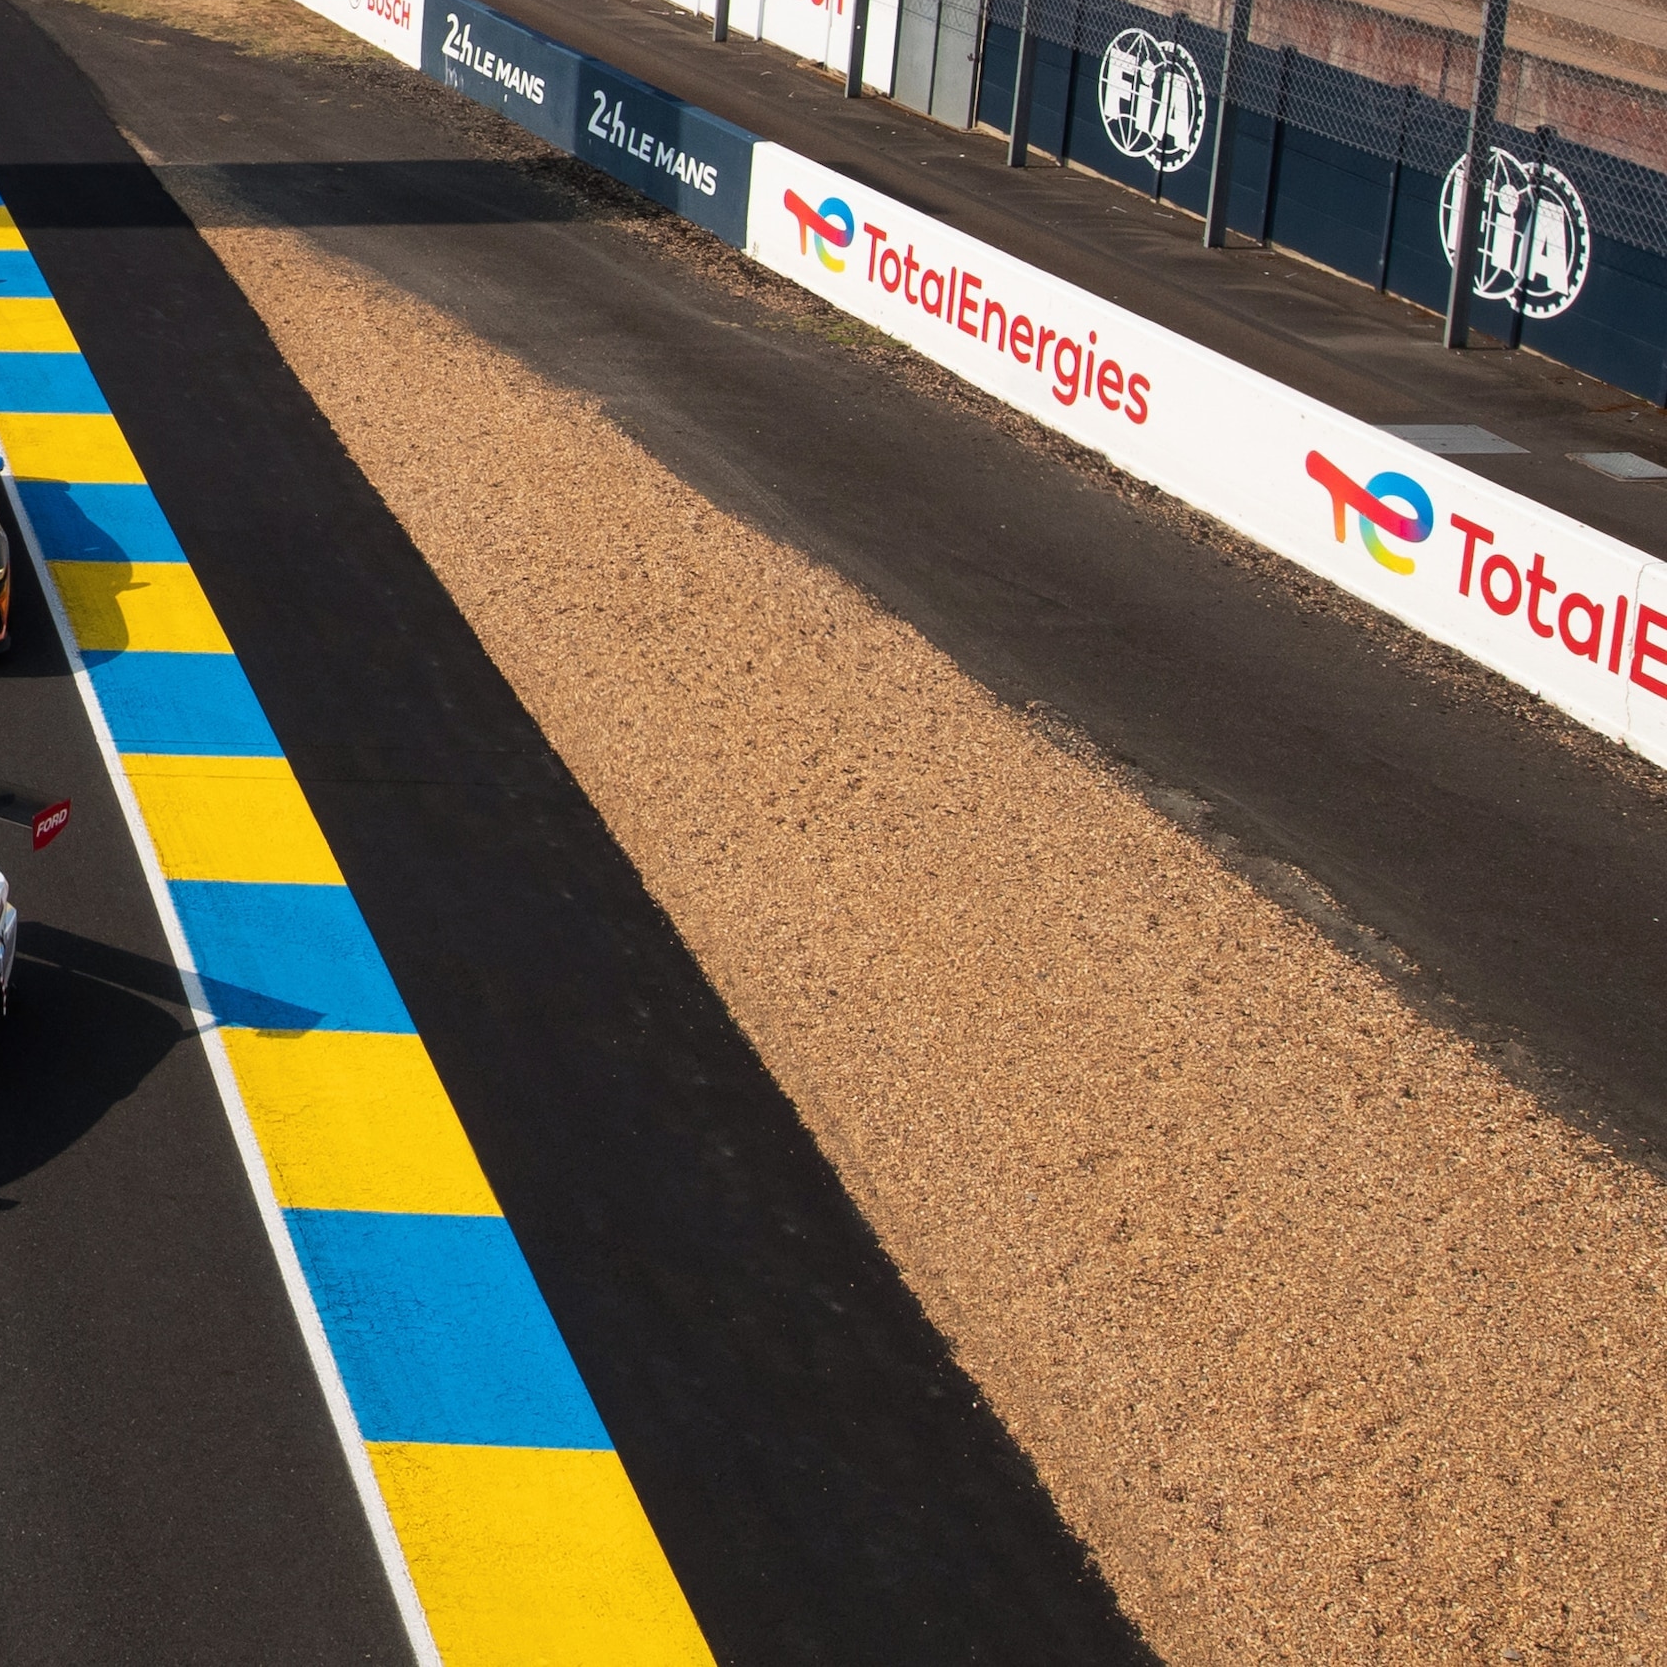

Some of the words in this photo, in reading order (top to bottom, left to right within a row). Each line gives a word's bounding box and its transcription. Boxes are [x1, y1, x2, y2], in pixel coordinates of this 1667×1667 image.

[442, 13, 473, 67] 24h
[474, 51, 493, 80] LE
[495, 59, 545, 105] MANS
[587, 90, 626, 146] 24h
[628, 133, 652, 164] LE
[655, 147, 718, 196] MANS
[863, 223, 1152, 426] TotalEnergies
[35, 807, 68, 838] FORD
